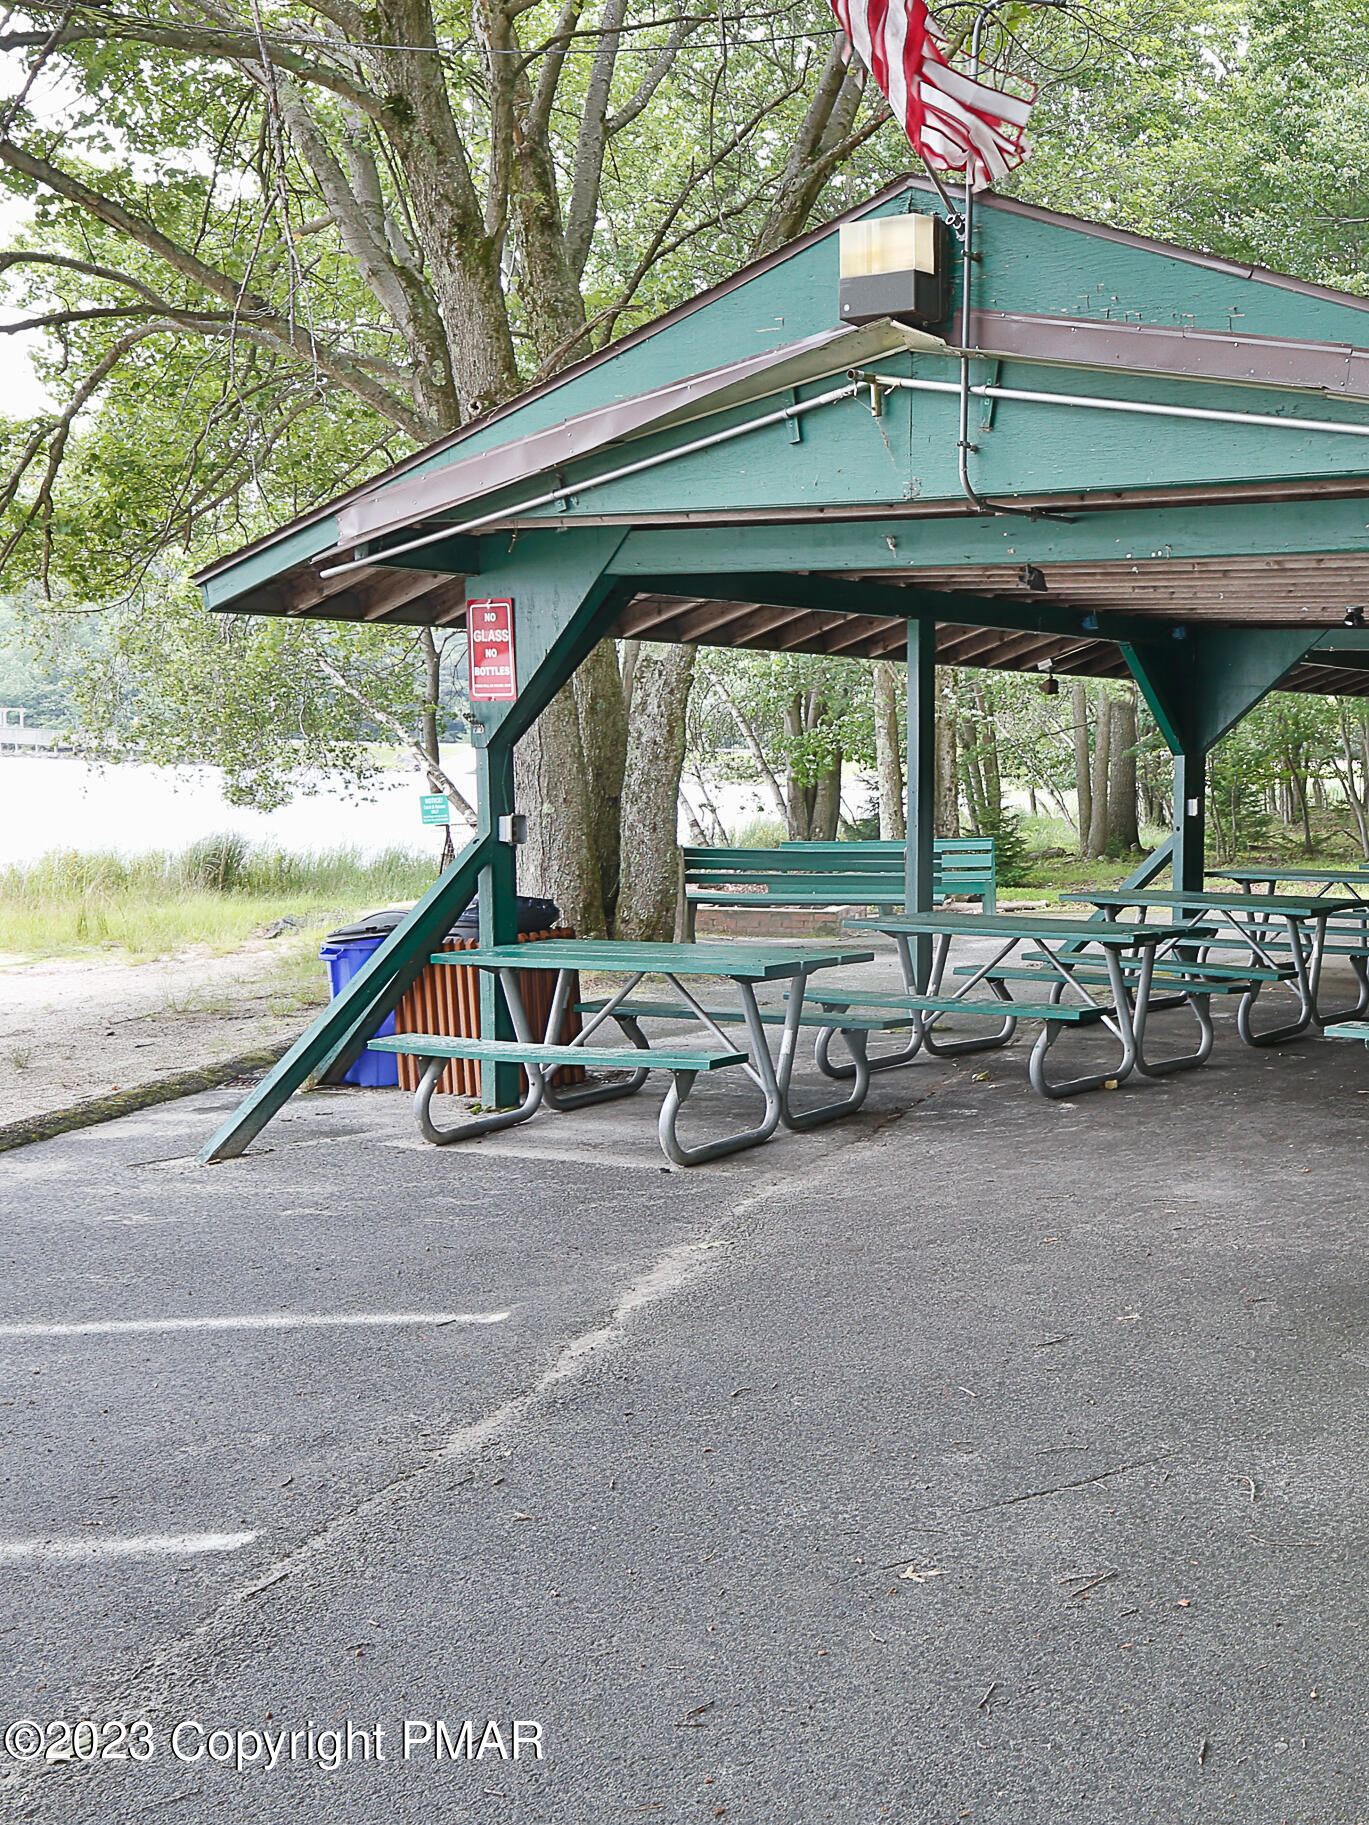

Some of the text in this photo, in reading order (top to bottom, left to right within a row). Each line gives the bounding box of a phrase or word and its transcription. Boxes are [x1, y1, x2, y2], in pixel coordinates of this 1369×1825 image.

[484, 612, 497, 622] NO
[473, 629, 509, 642] GLASS
[485, 648, 498, 658] NO
[474, 666, 511, 676] BOTTLES
